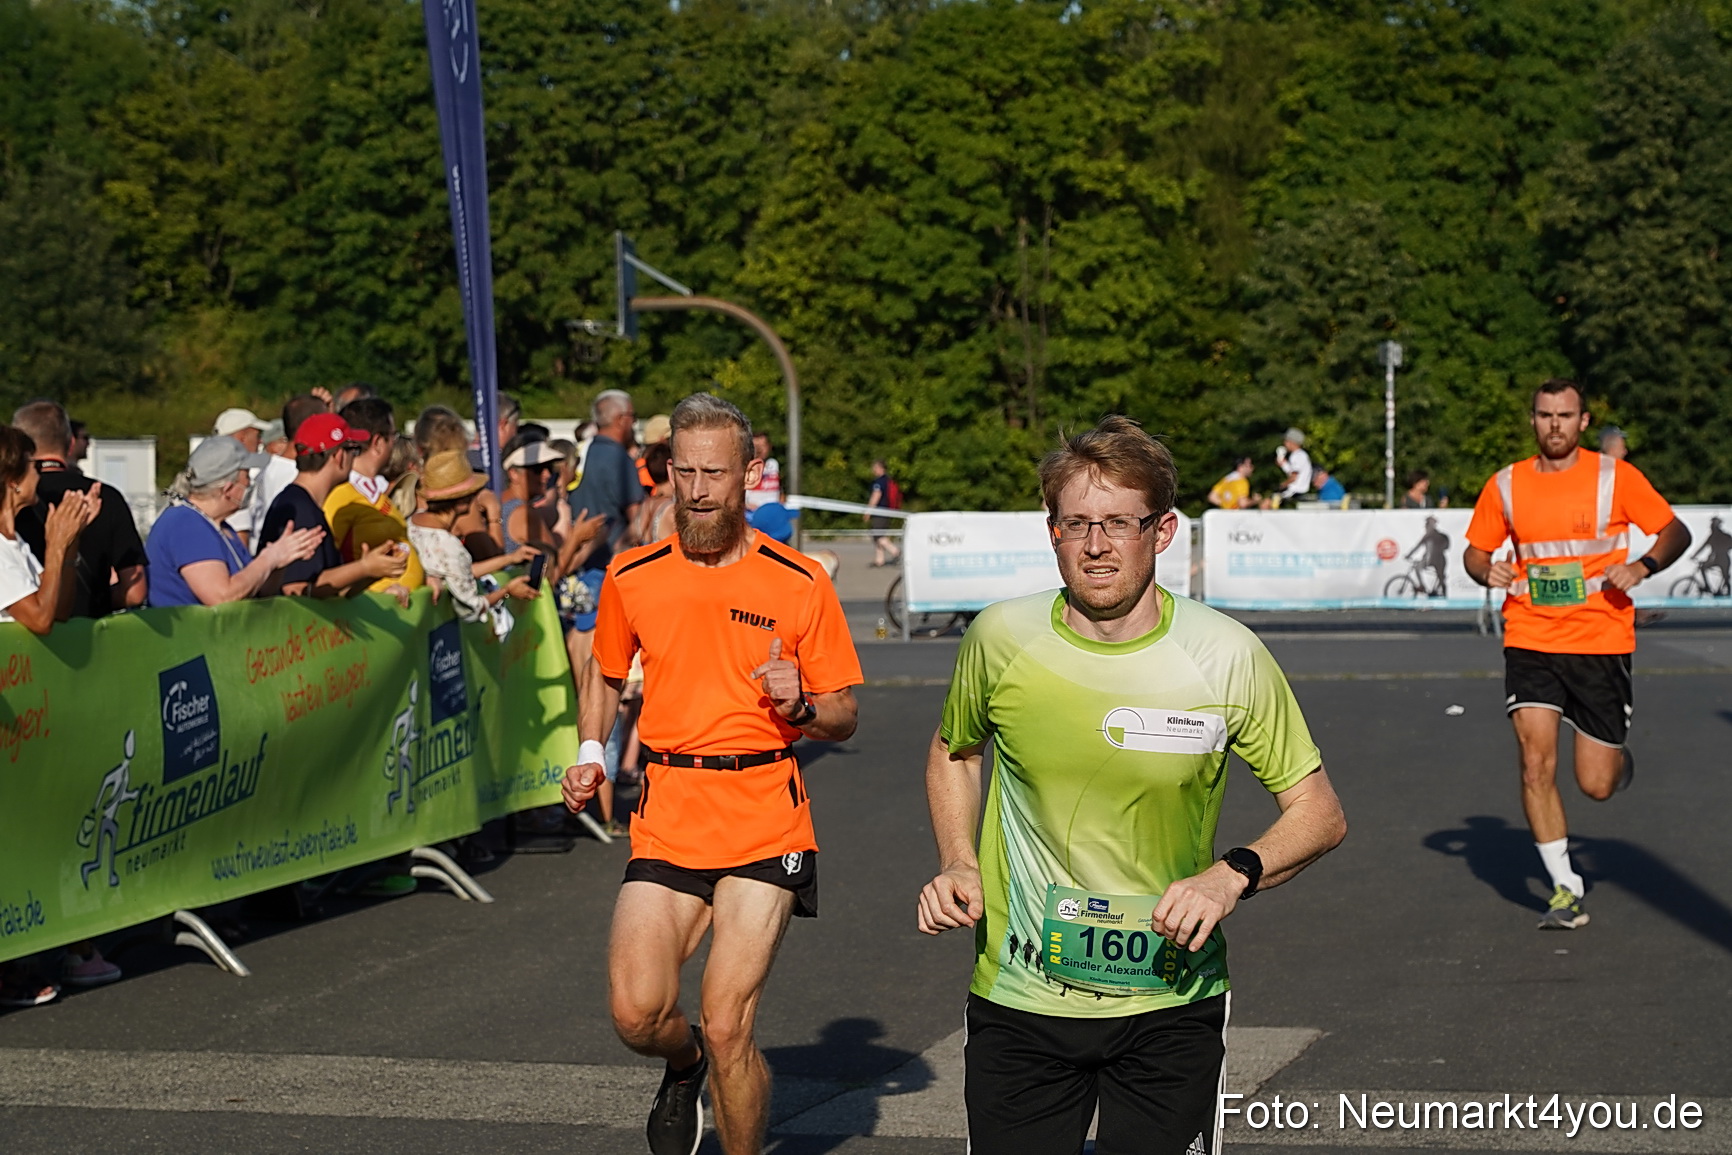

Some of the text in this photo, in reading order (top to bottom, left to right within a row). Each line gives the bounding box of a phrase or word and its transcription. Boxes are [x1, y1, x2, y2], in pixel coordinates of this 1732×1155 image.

[1541, 579, 1570, 593] 798
[730, 608, 776, 631] THULE
[172, 694, 209, 724] Fischer
[1166, 726, 1203, 735] Neumarkt
[1167, 716, 1205, 727] Klinikum
[128, 732, 268, 847] firmenlauf
[126, 831, 186, 876] neumarkt
[1080, 910, 1125, 920] Firmenlauf
[1049, 932, 1063, 965] RUN
[1079, 926, 1149, 963] 160
[1061, 956, 1163, 977] Gindler Alexander
